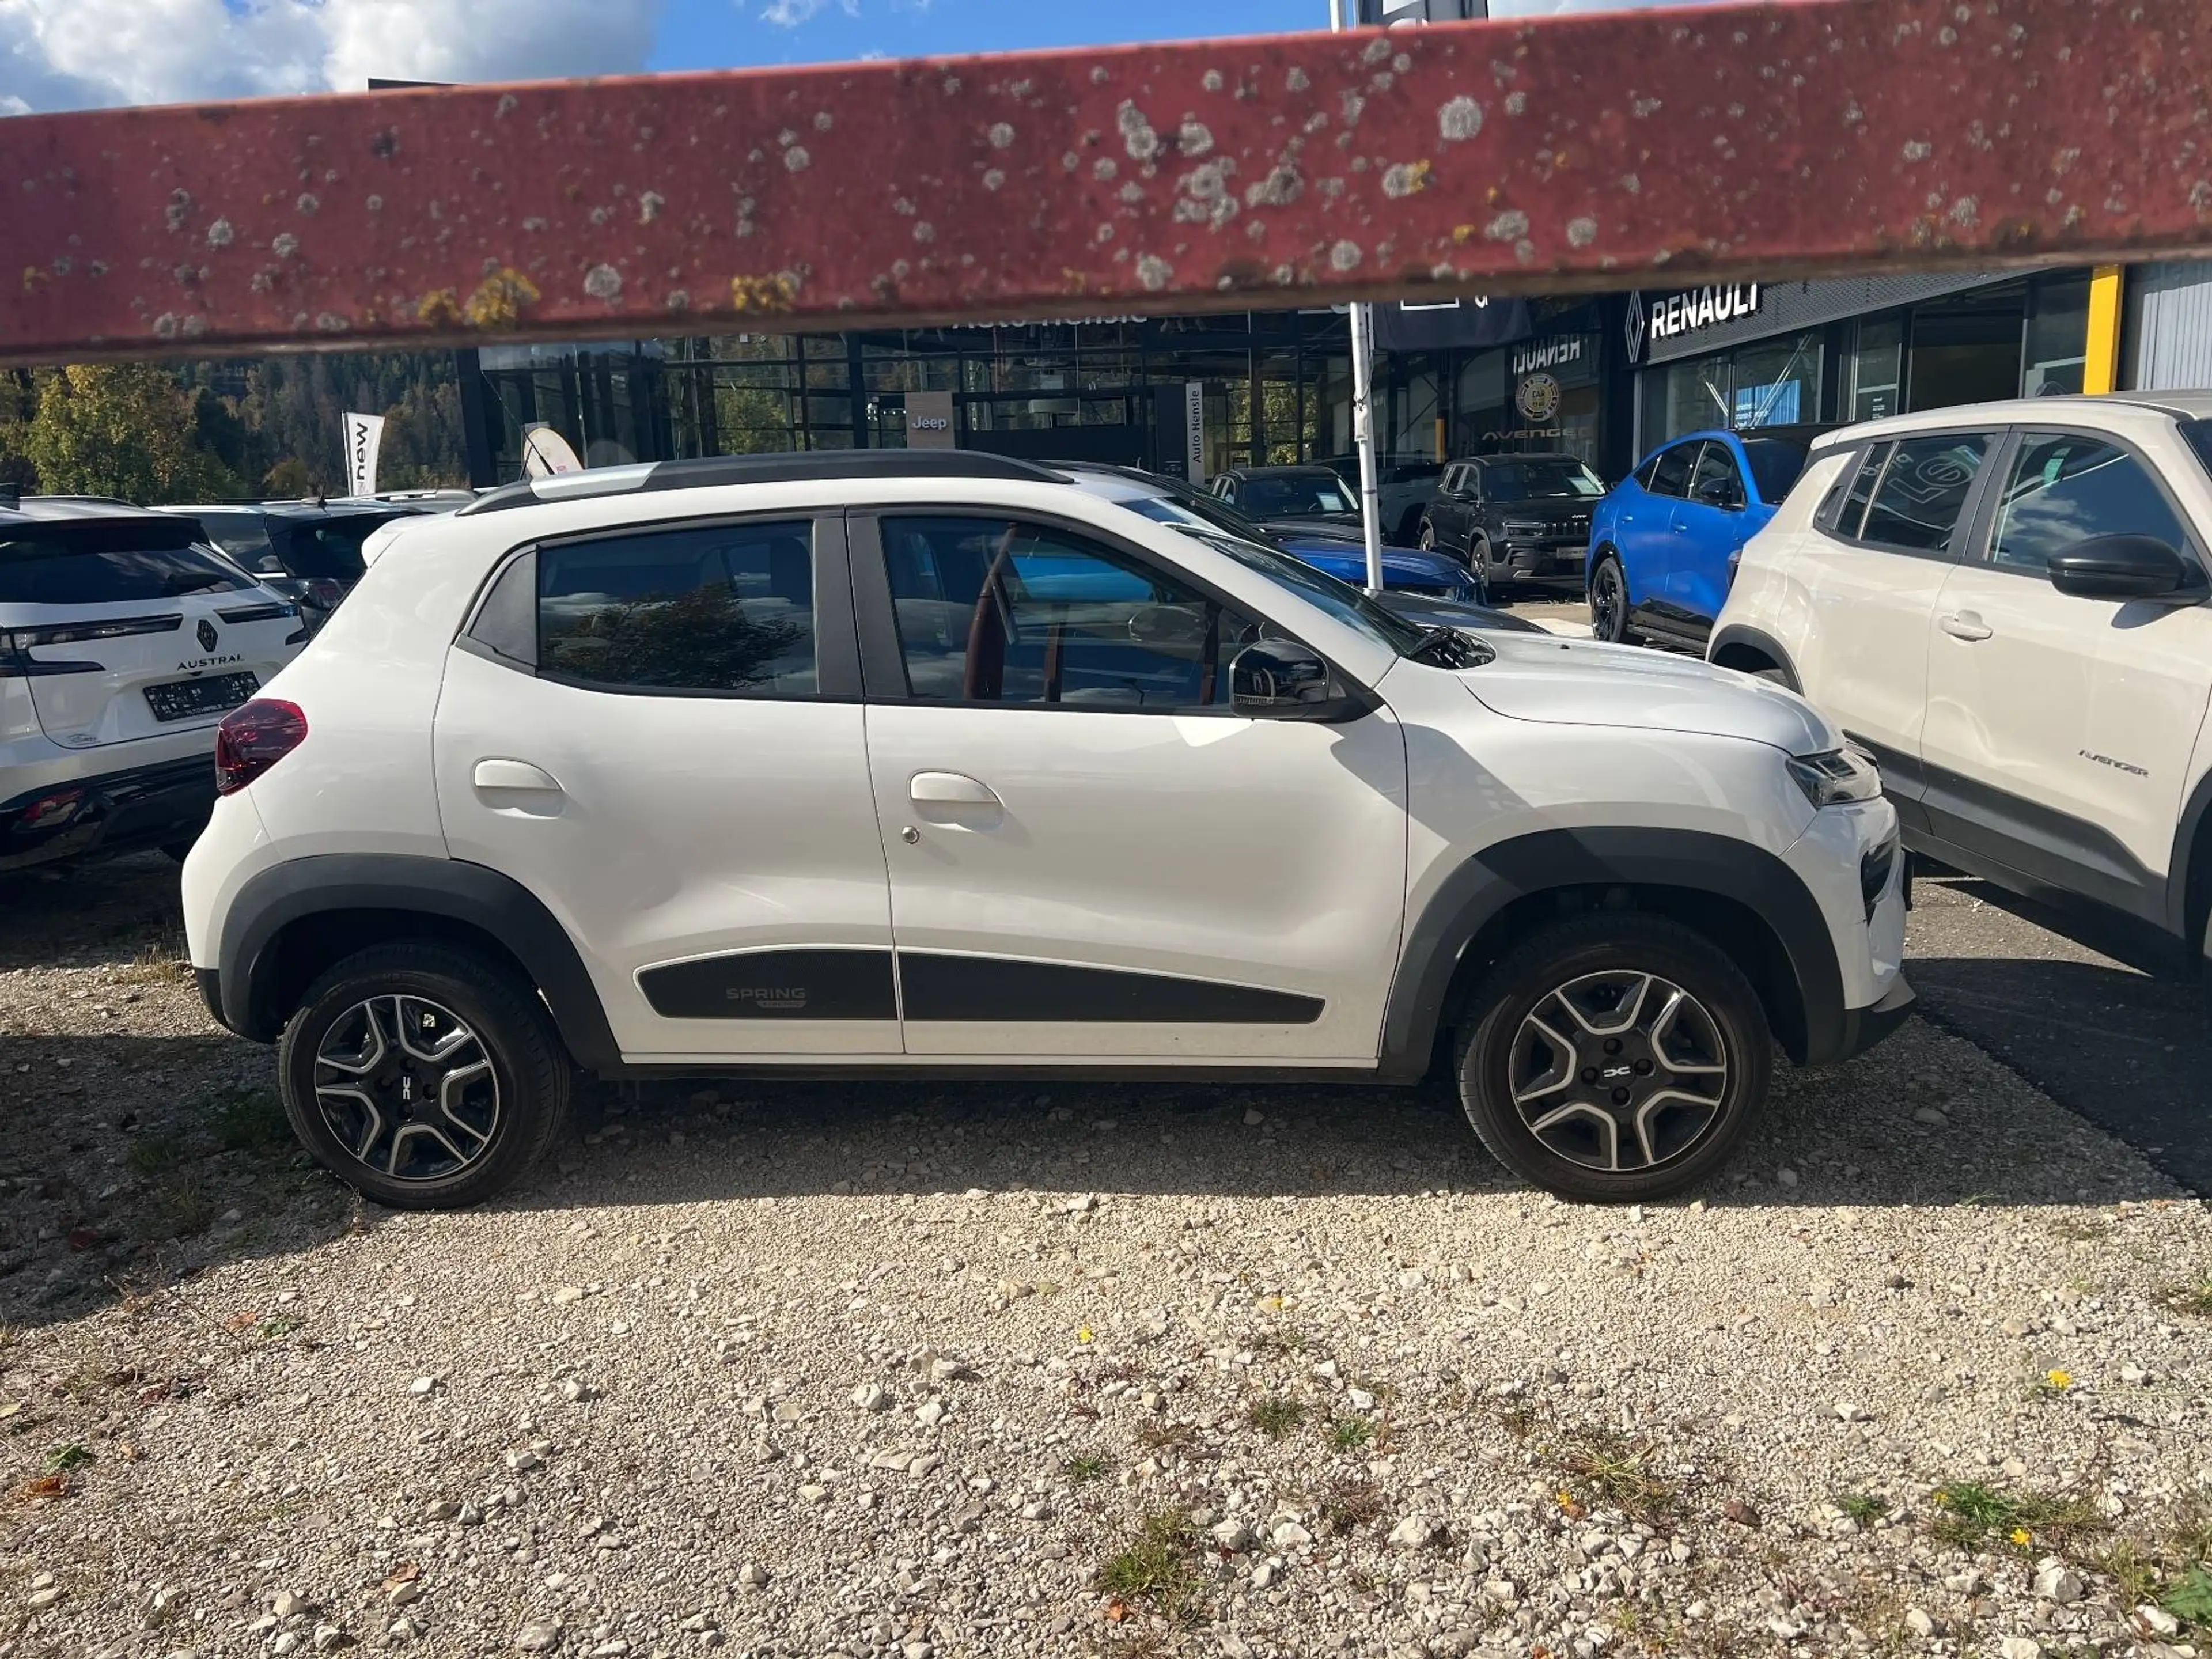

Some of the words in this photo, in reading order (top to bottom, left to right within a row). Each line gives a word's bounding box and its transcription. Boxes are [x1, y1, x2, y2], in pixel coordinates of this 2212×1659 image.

[1190, 391, 1200, 431] Hensle
[912, 416, 946, 430] Jeep
[1192, 435, 1202, 463] Auto
[177, 654, 245, 671] AUSTRAL
[726, 987, 806, 999] SPRING
